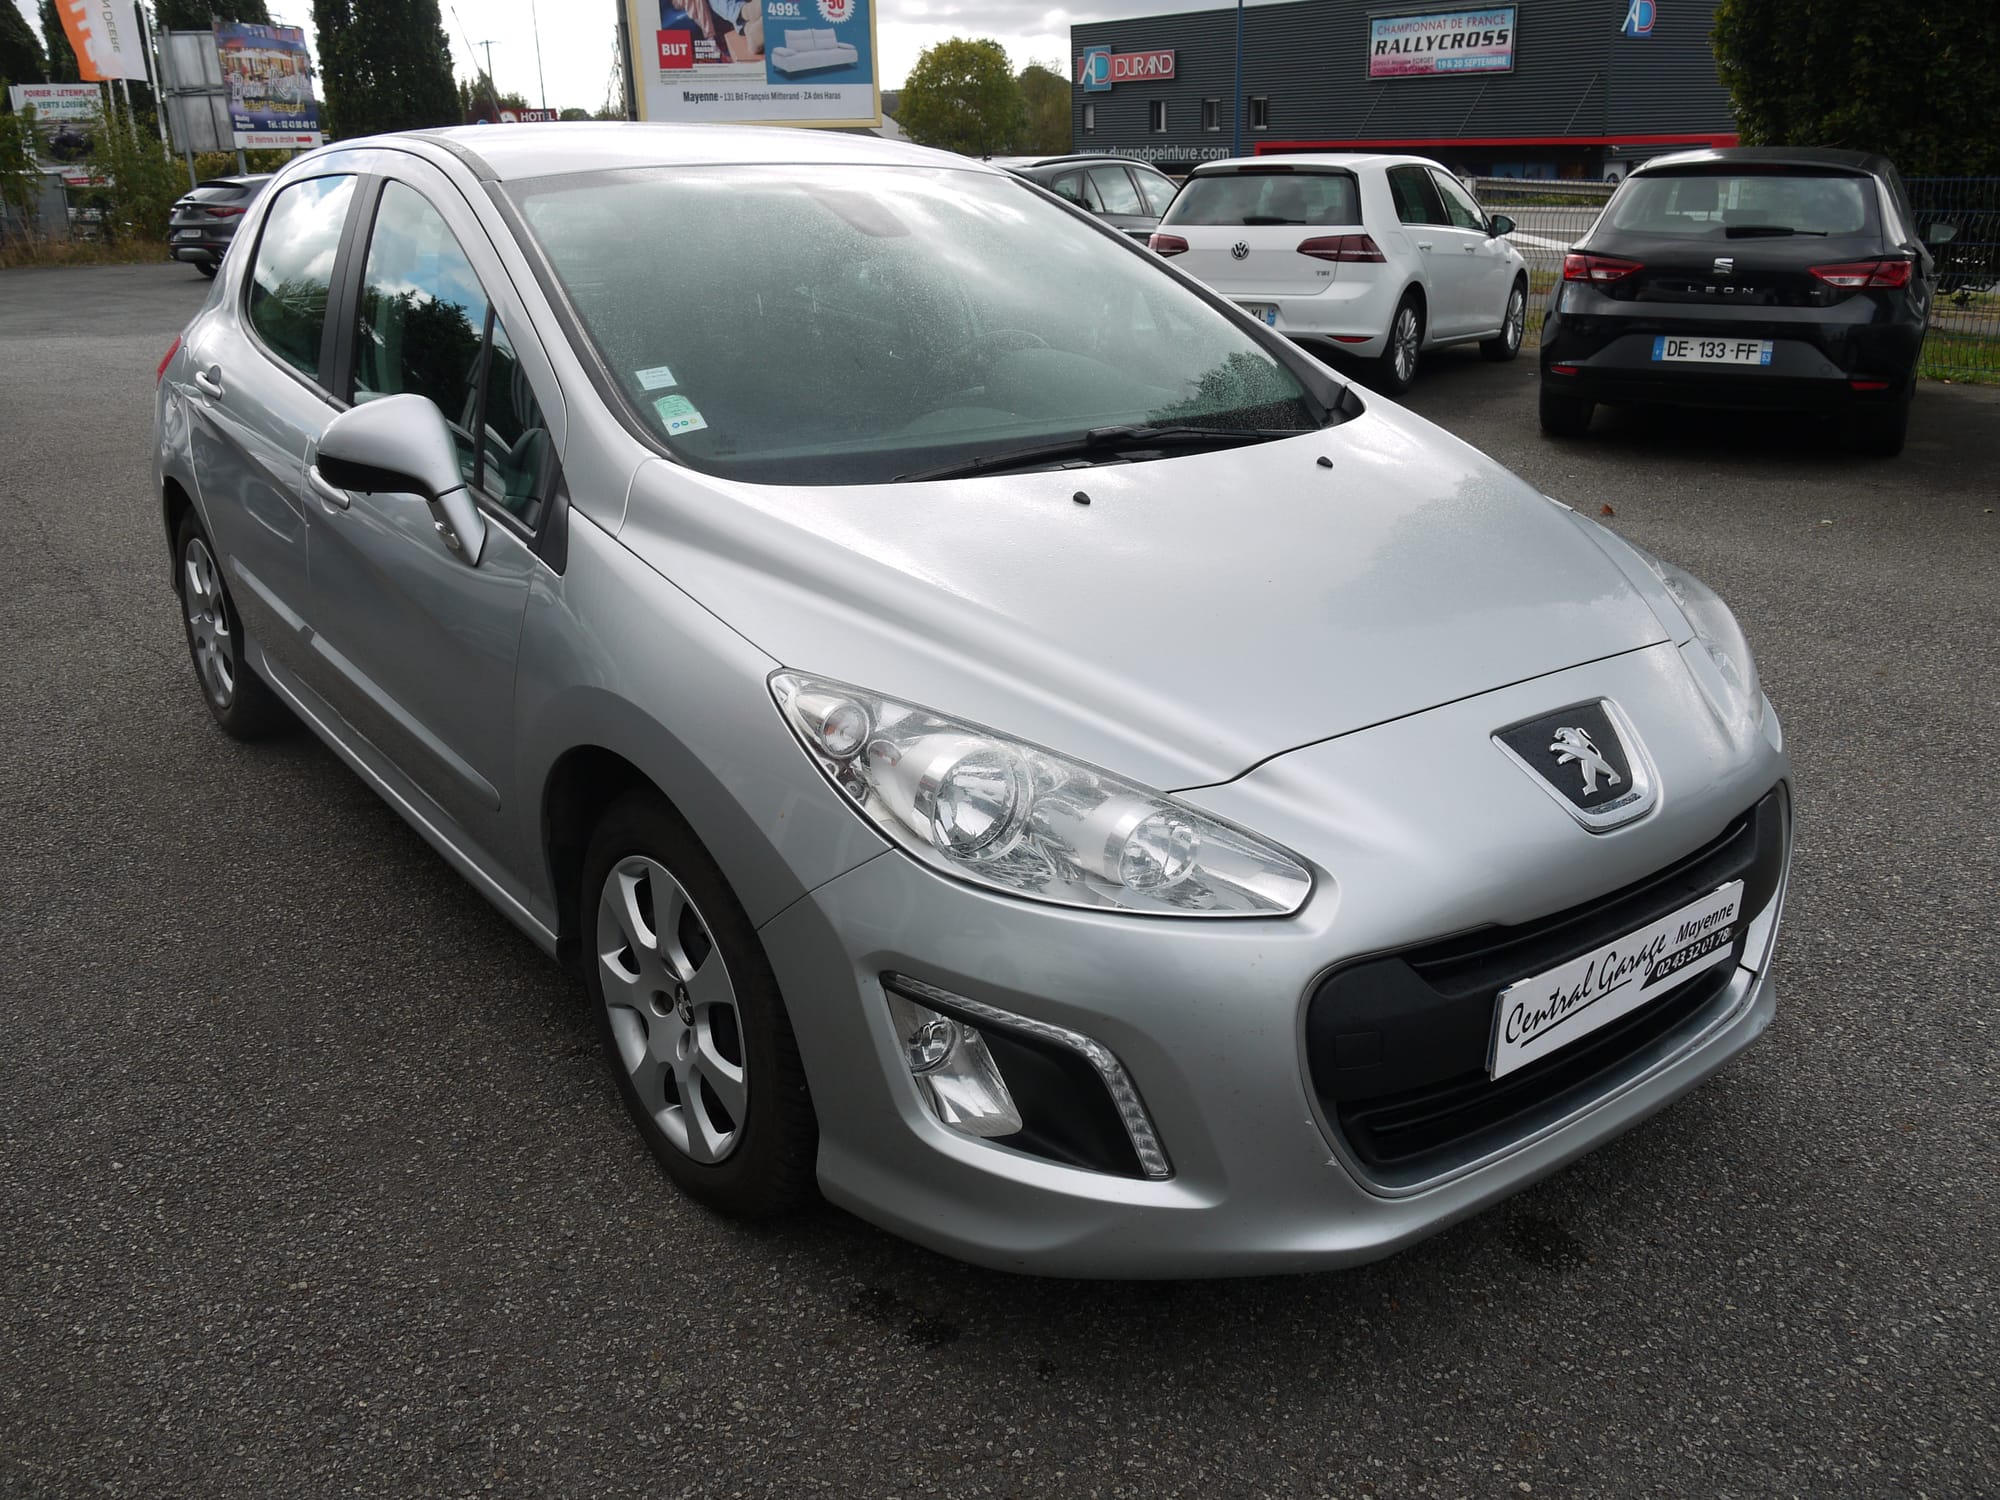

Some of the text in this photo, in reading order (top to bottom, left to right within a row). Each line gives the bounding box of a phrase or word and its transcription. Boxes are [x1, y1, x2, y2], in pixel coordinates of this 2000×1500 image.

[102, 11, 121, 53] DEERE
[1377, 14, 1506, 36] CHAMPIONNAT DE FRANCE
[661, 43, 688, 56] BUT
[1375, 28, 1510, 56] RALLYCROSS
[1115, 54, 1173, 77] DURAND
[1464, 56, 1507, 67] SEPTEMBRE
[683, 91, 719, 104] Mayenne
[724, 92, 735, 101] 131
[735, 92, 743, 101] Bd
[744, 92, 769, 102] François
[813, 92, 823, 100] des
[1079, 144, 1230, 163] wwwdurandpeinture.com
[1687, 285, 1754, 295] LEON
[1505, 903, 1734, 1044] Central Garage Mayenne
